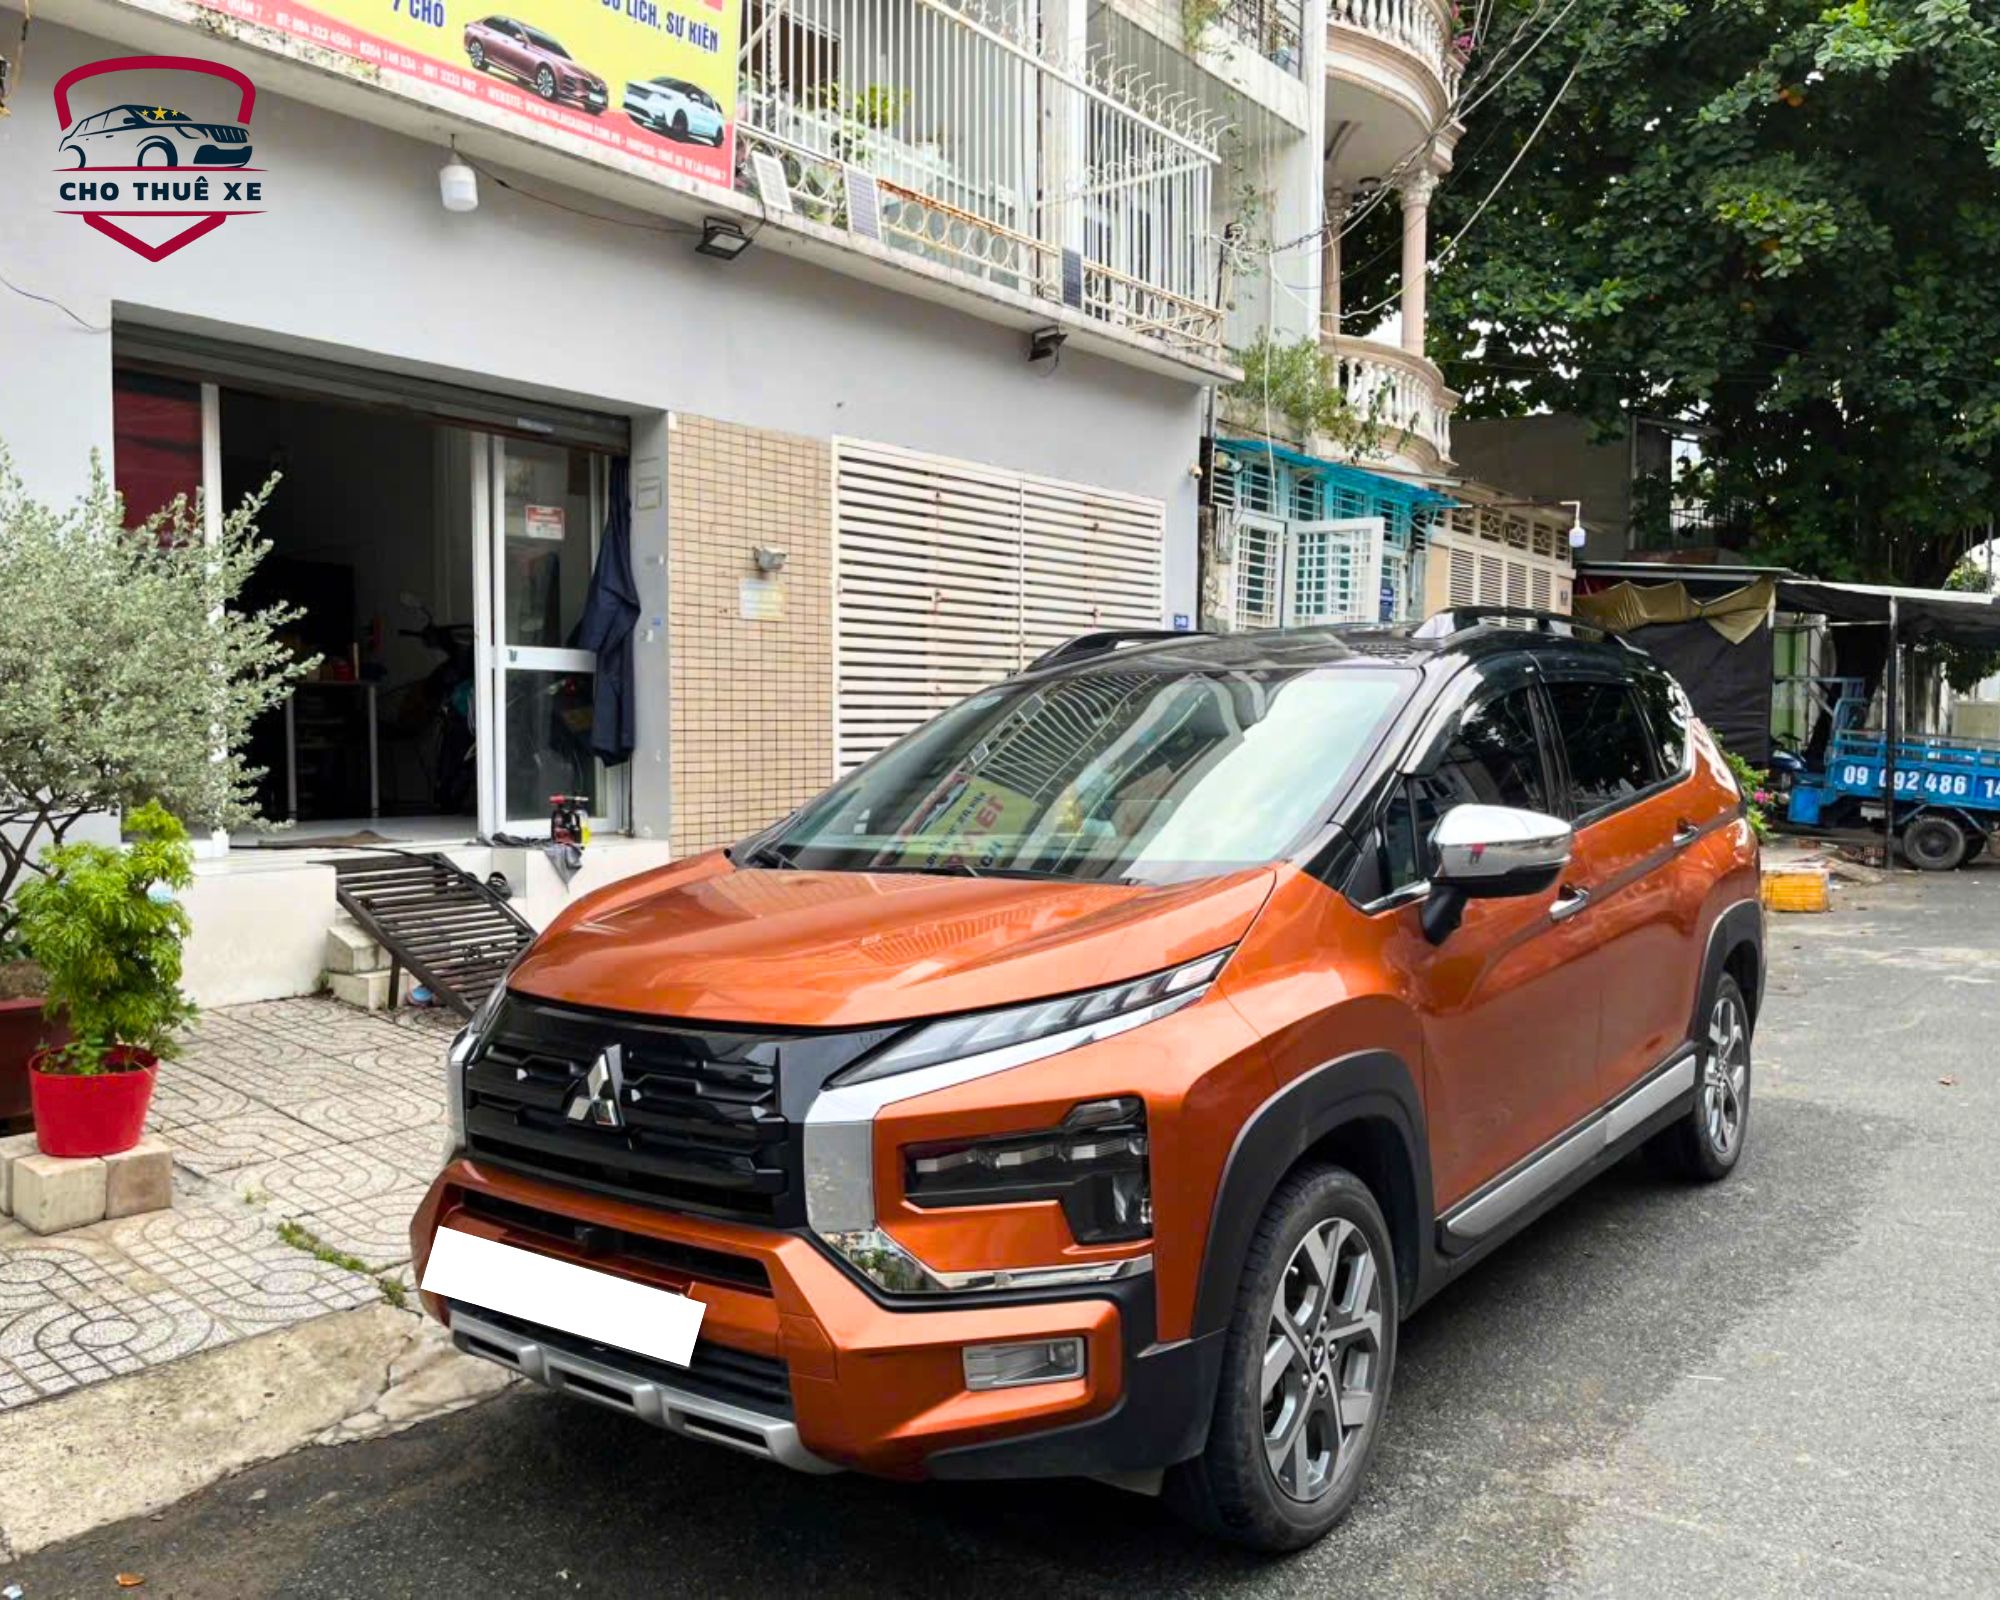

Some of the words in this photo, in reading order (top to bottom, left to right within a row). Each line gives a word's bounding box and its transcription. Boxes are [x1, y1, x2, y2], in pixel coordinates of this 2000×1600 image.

[665, 11, 685, 41] SỰ
[688, 20, 718, 54] KIỆN
[1843, 765, 1869, 785] 09
[1924, 773, 1968, 795] 486
